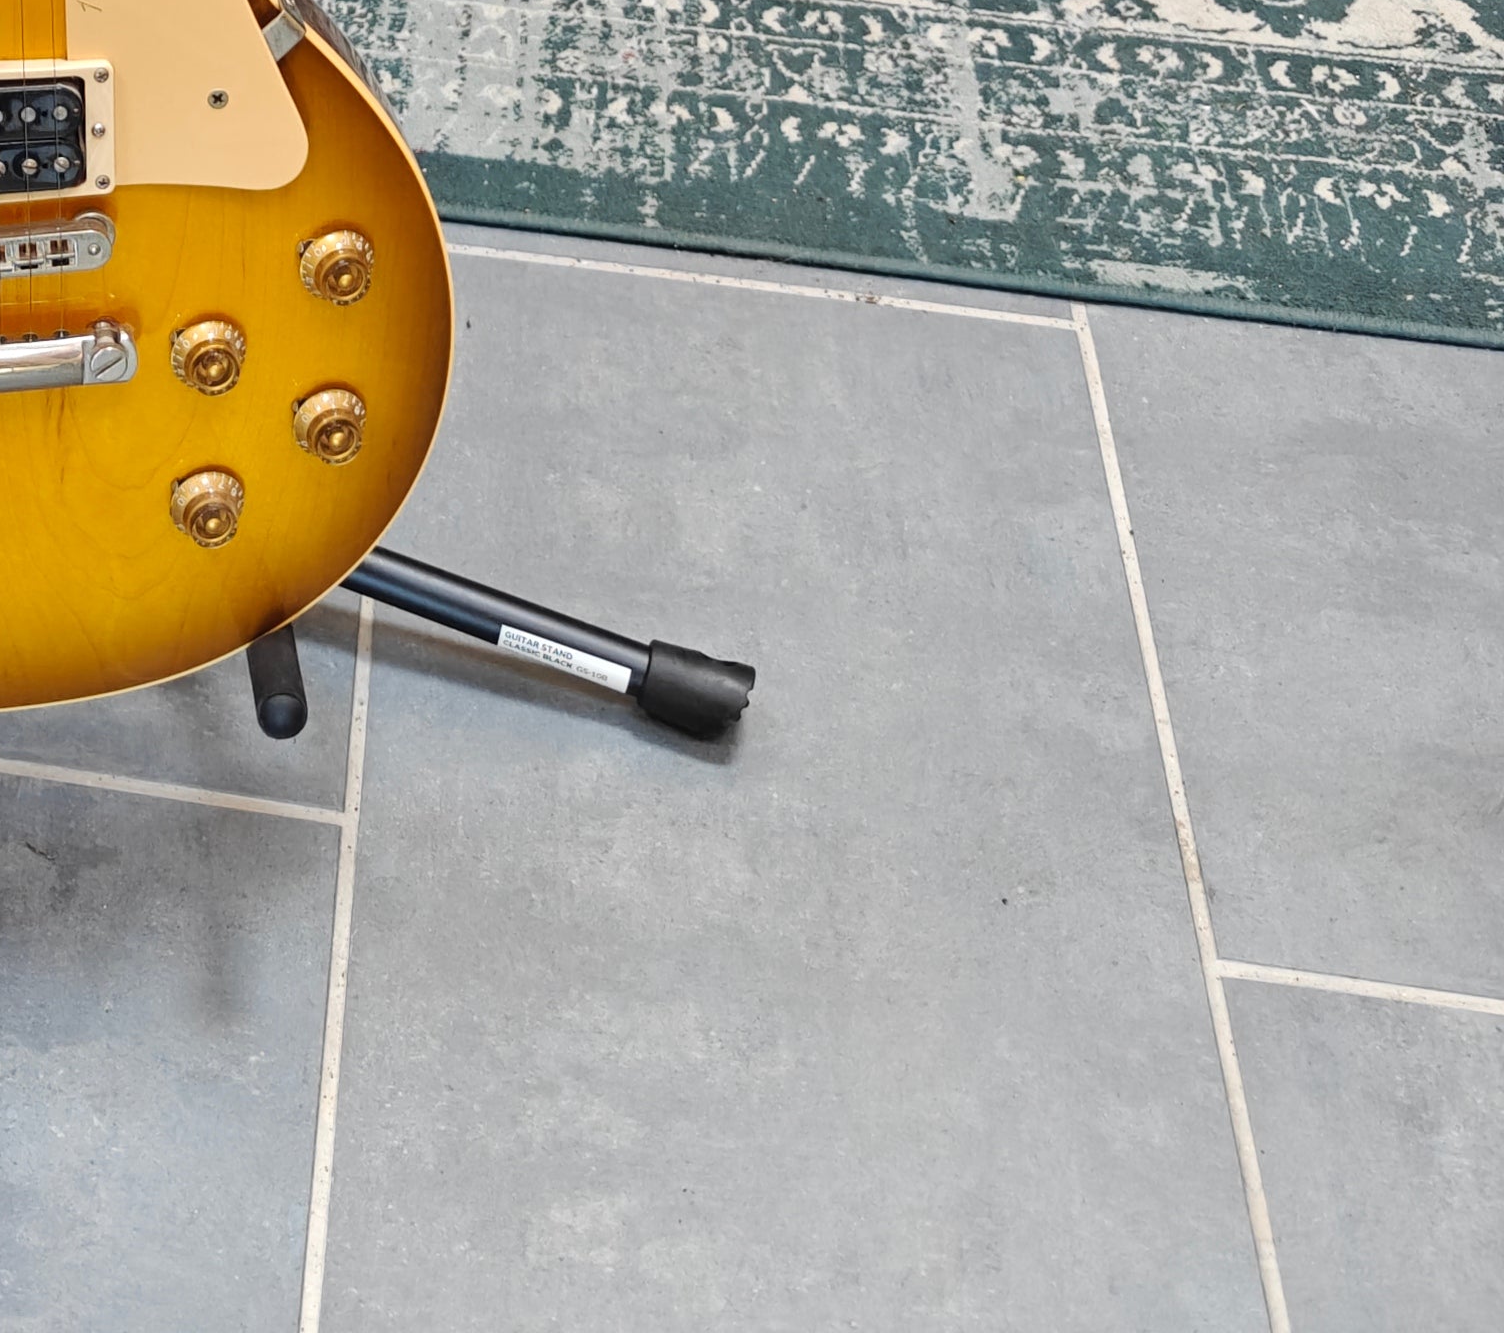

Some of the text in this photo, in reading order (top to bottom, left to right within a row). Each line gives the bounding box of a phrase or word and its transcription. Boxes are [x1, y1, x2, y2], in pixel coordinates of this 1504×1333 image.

[503, 639, 541, 658] CLASSIC
[542, 653, 573, 669] BLACK
[504, 631, 573, 661] GUITAR STAND
